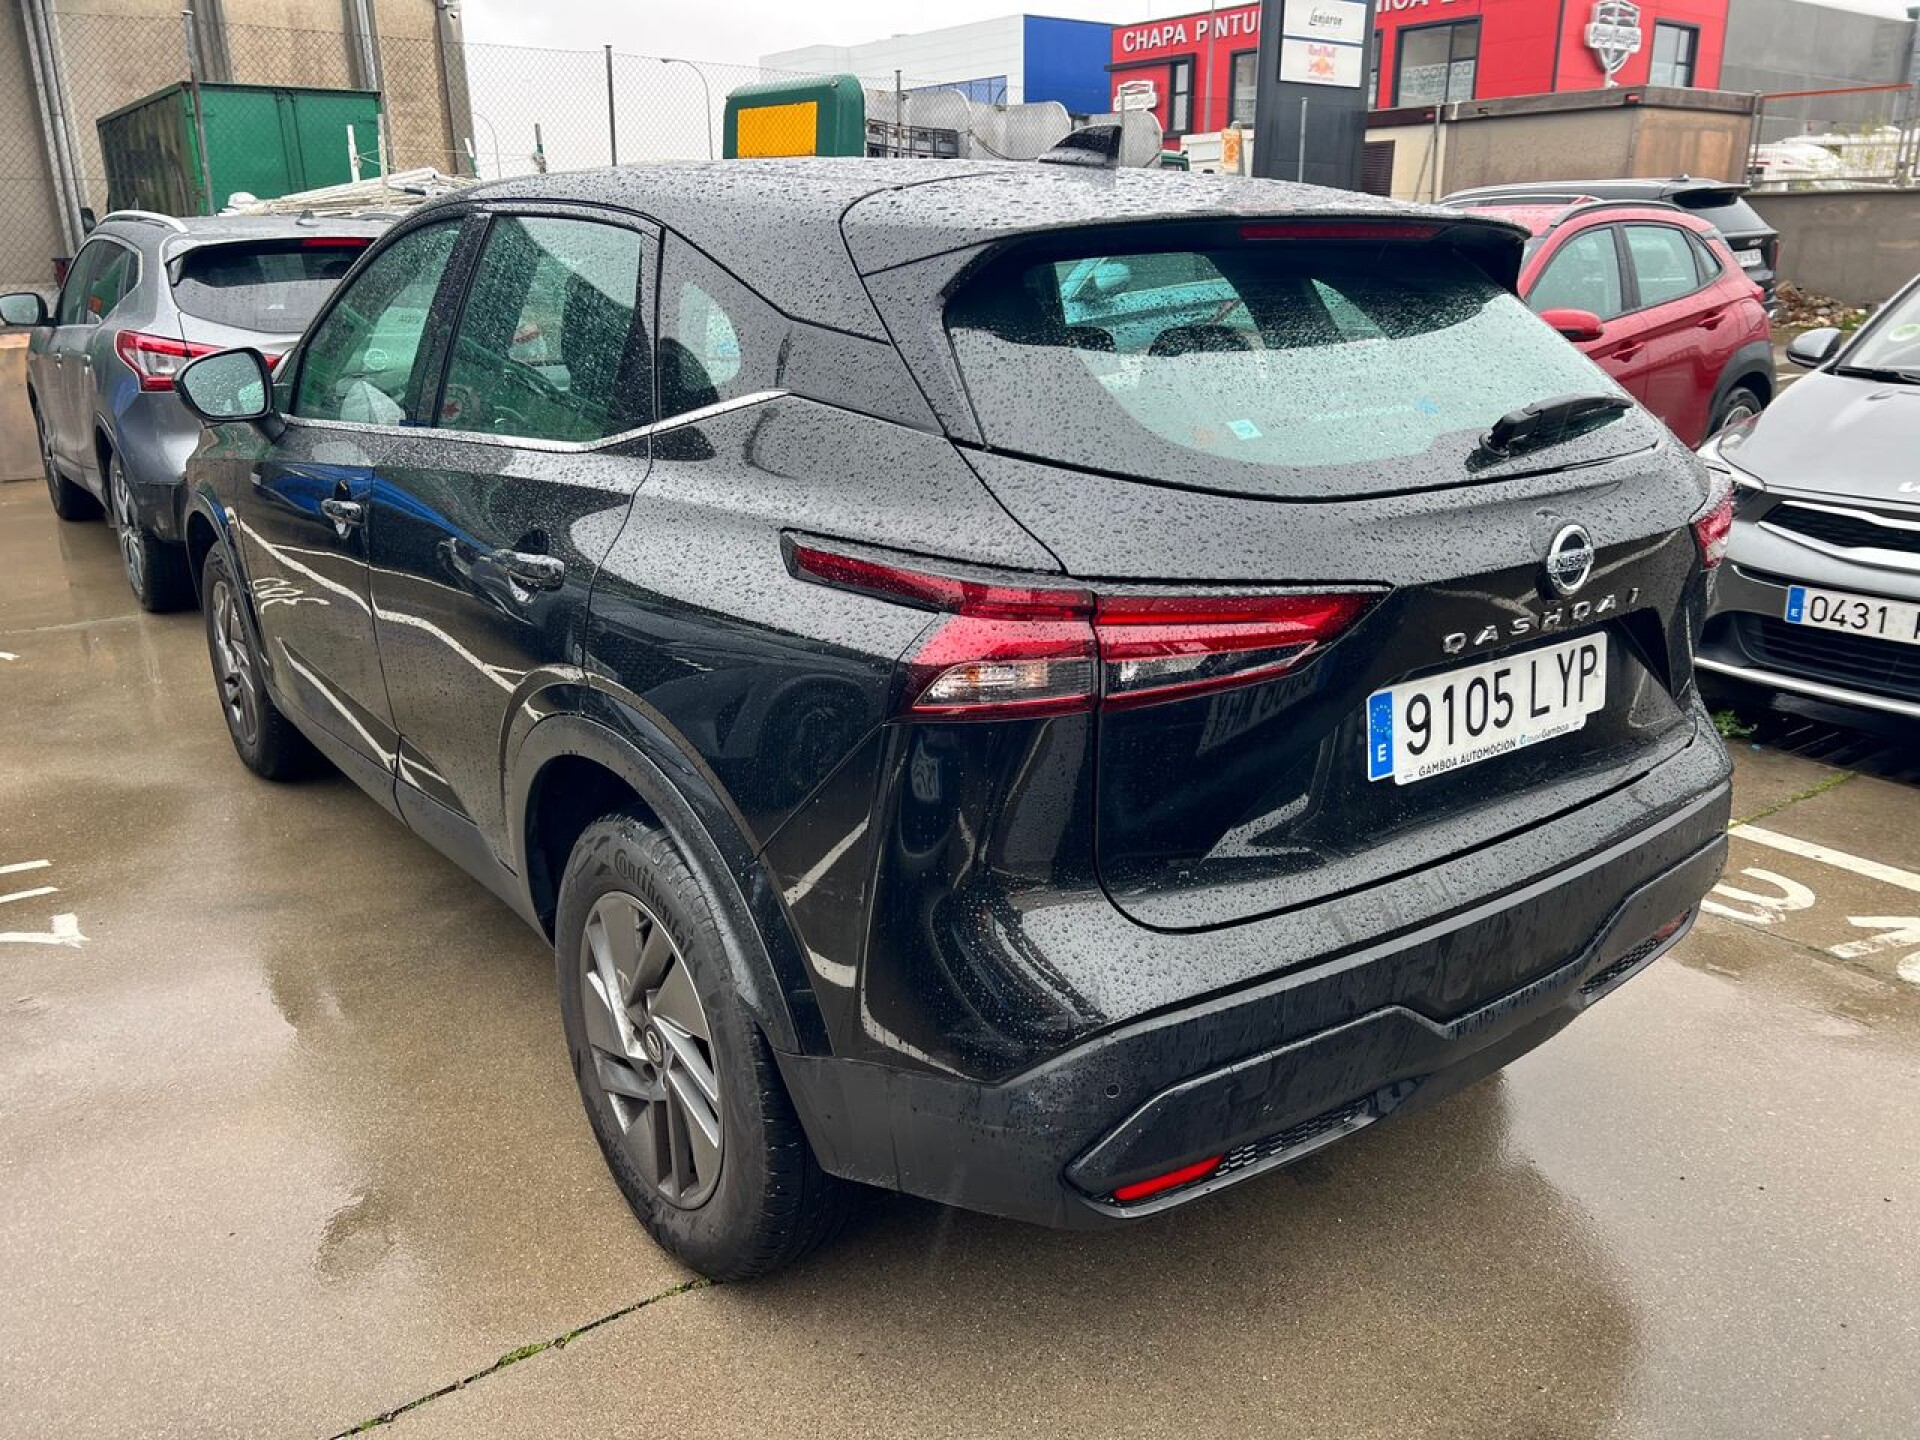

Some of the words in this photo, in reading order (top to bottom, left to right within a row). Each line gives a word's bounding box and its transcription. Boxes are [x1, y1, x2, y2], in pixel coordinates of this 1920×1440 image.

[1122, 23, 1188, 52] CHAPA
[1195, 11, 1260, 42] PNTU
[1442, 587, 1640, 655] QASHQAI
[1810, 596, 1888, 634] 0431
[1377, 743, 1387, 763] E
[1406, 668, 1514, 756] 9105
[1530, 644, 1598, 719] LYP
[1418, 757, 1458, 778] GAMBOA
[1460, 739, 1516, 764] AUTOMOCION
